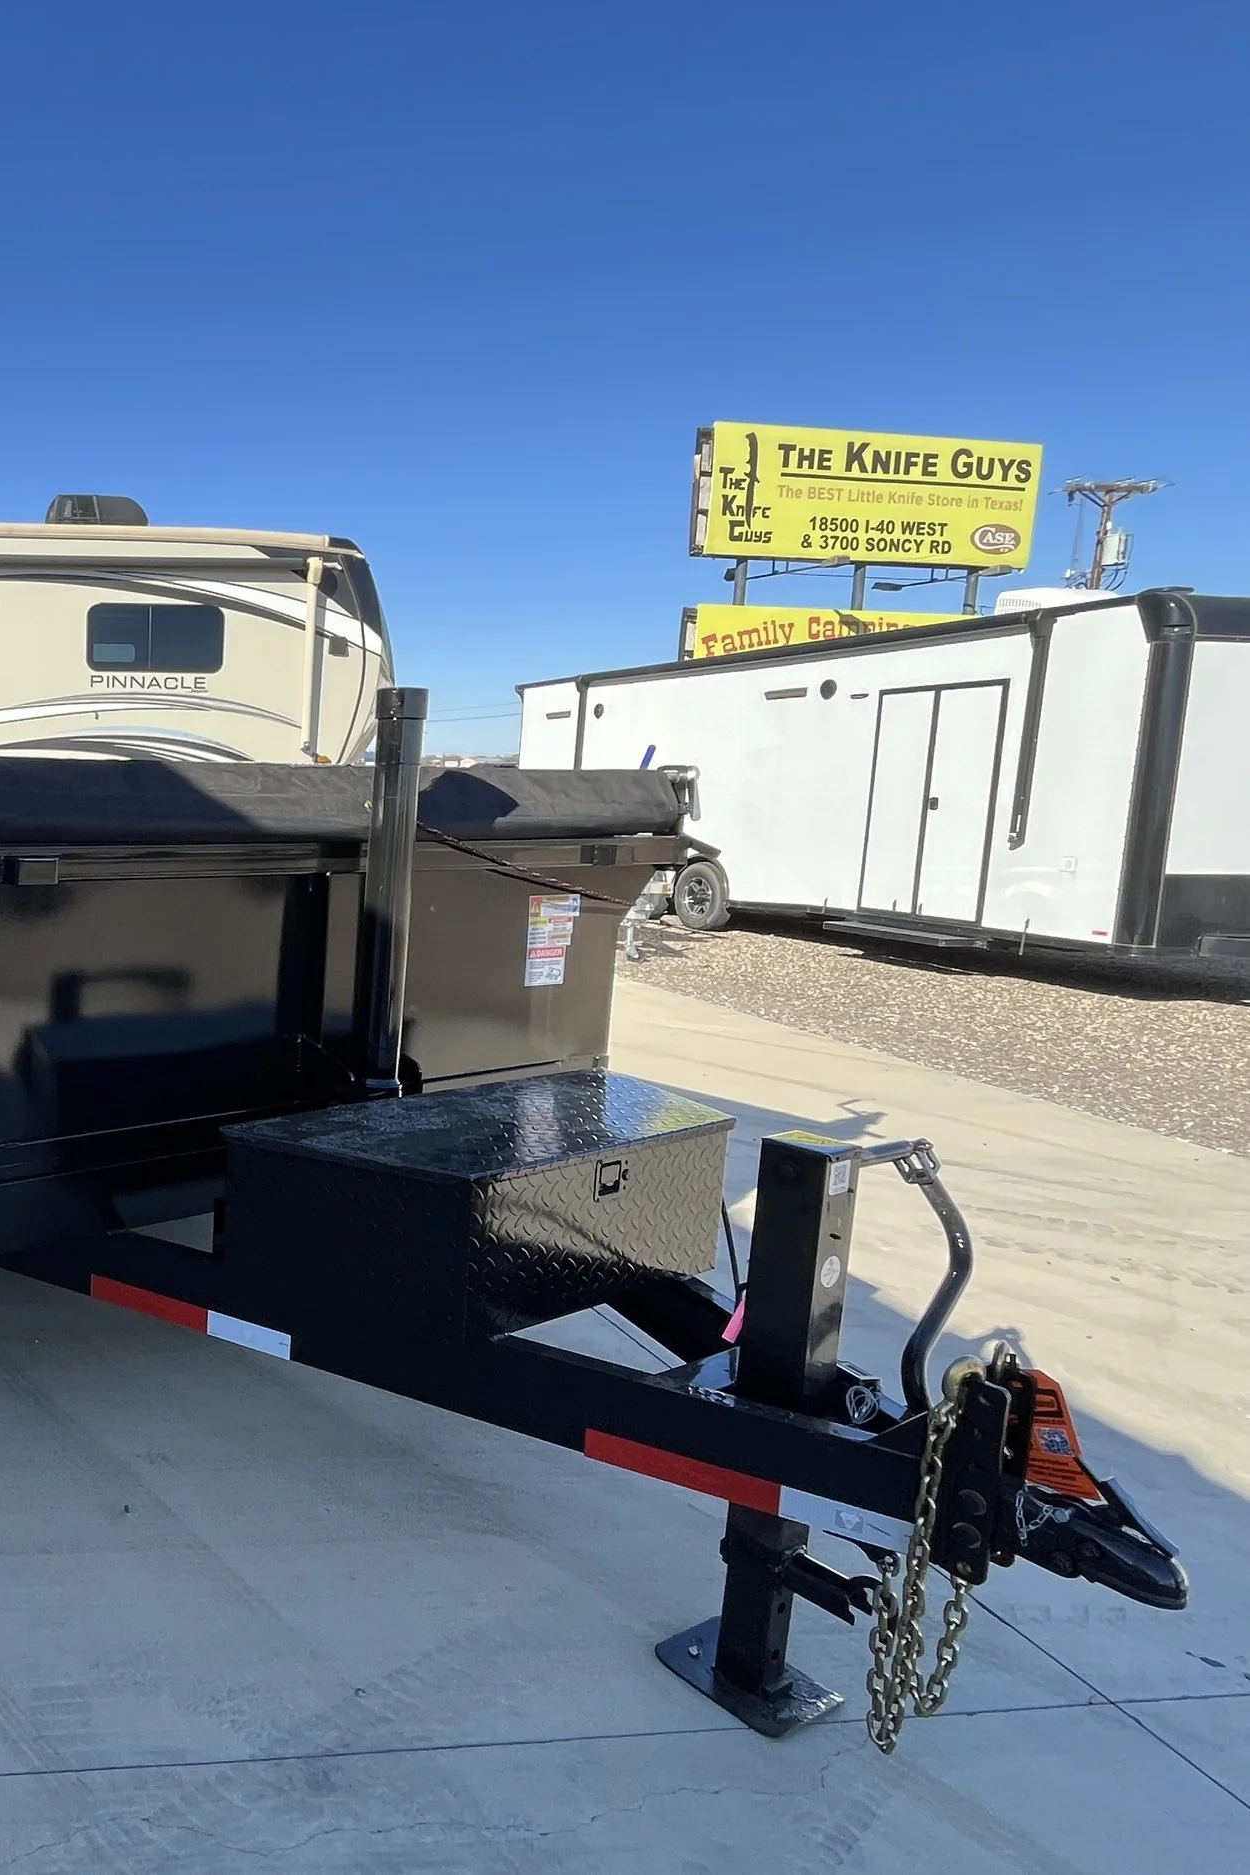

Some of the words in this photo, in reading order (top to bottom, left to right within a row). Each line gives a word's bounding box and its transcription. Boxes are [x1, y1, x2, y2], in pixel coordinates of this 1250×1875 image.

[777, 443, 833, 471] THE
[844, 441, 939, 477] KNIFE
[950, 448, 1032, 484] GUYS
[777, 484, 803, 499] The
[807, 486, 844, 502] BEST
[848, 488, 884, 504] Little
[887, 491, 923, 506] Knife
[927, 493, 963, 507] Store
[967, 495, 979, 508] in
[984, 496, 1024, 512] Texas!
[809, 516, 859, 534] 18500
[864, 519, 896, 535] I-40
[900, 520, 948, 537] WEST
[800, 533, 813, 549] &
[819, 534, 860, 552] 3700
[864, 537, 925, 554] SONCY
[929, 539, 952, 555] RD
[701, 620, 795, 657] Family
[90, 675, 206, 690] PINNACLE
